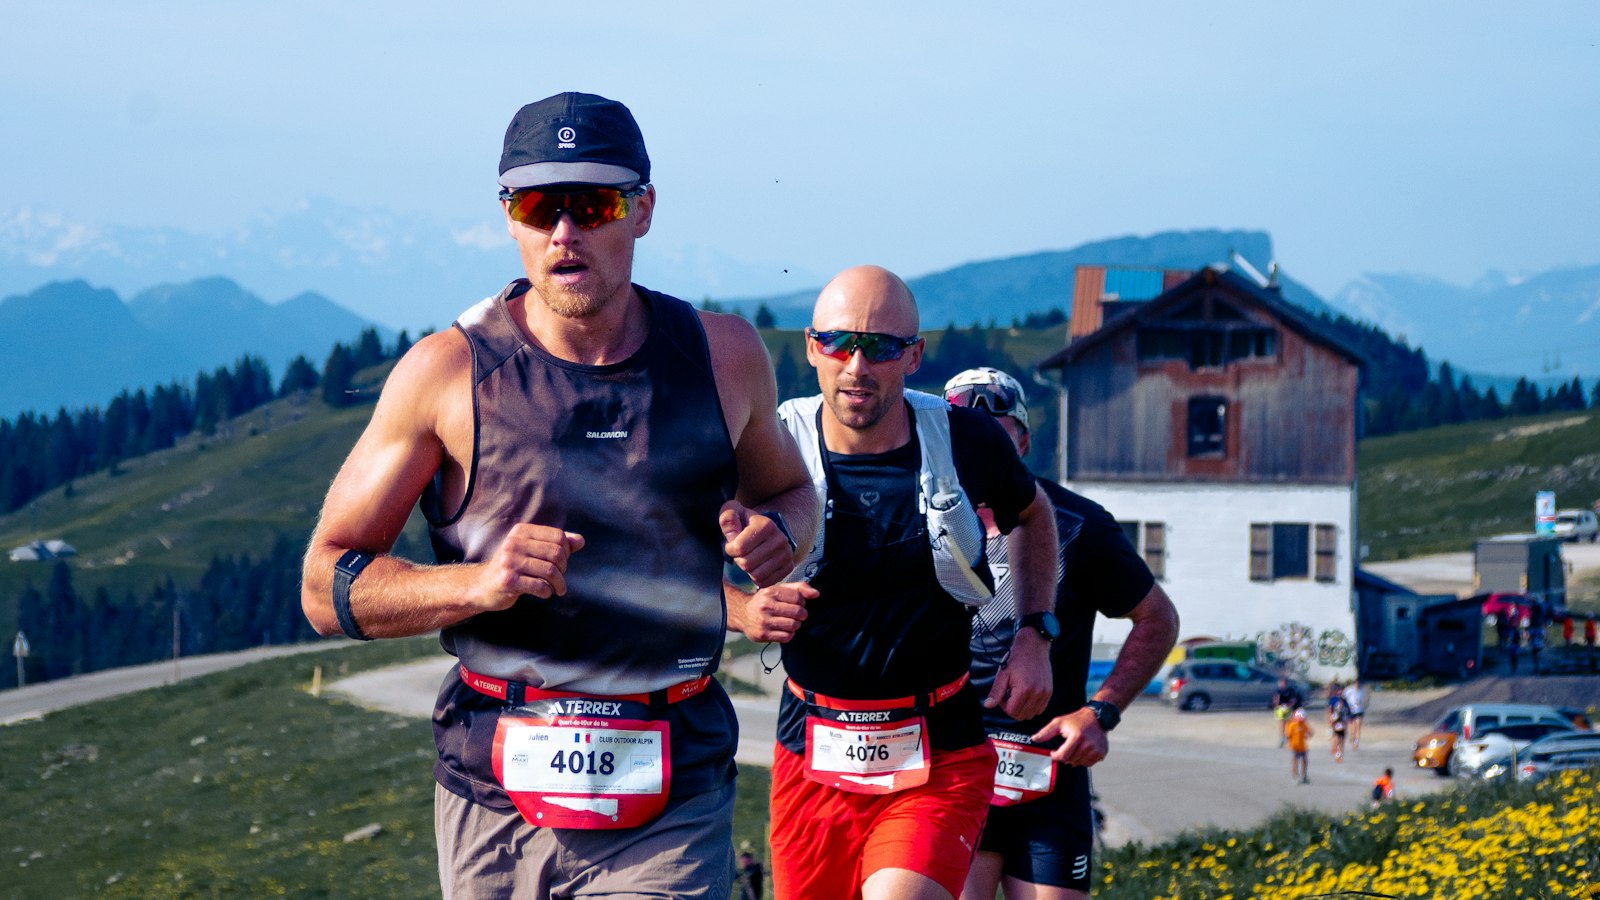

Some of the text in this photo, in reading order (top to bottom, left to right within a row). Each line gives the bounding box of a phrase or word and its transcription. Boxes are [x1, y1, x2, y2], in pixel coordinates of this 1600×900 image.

[480, 680, 502, 693] TERREX
[566, 700, 622, 716] TERREX
[849, 711, 891, 722] TERREX
[999, 732, 1032, 744] TERREX
[845, 744, 889, 762] 4076
[550, 750, 615, 776] 4018
[998, 761, 1025, 778] 032
